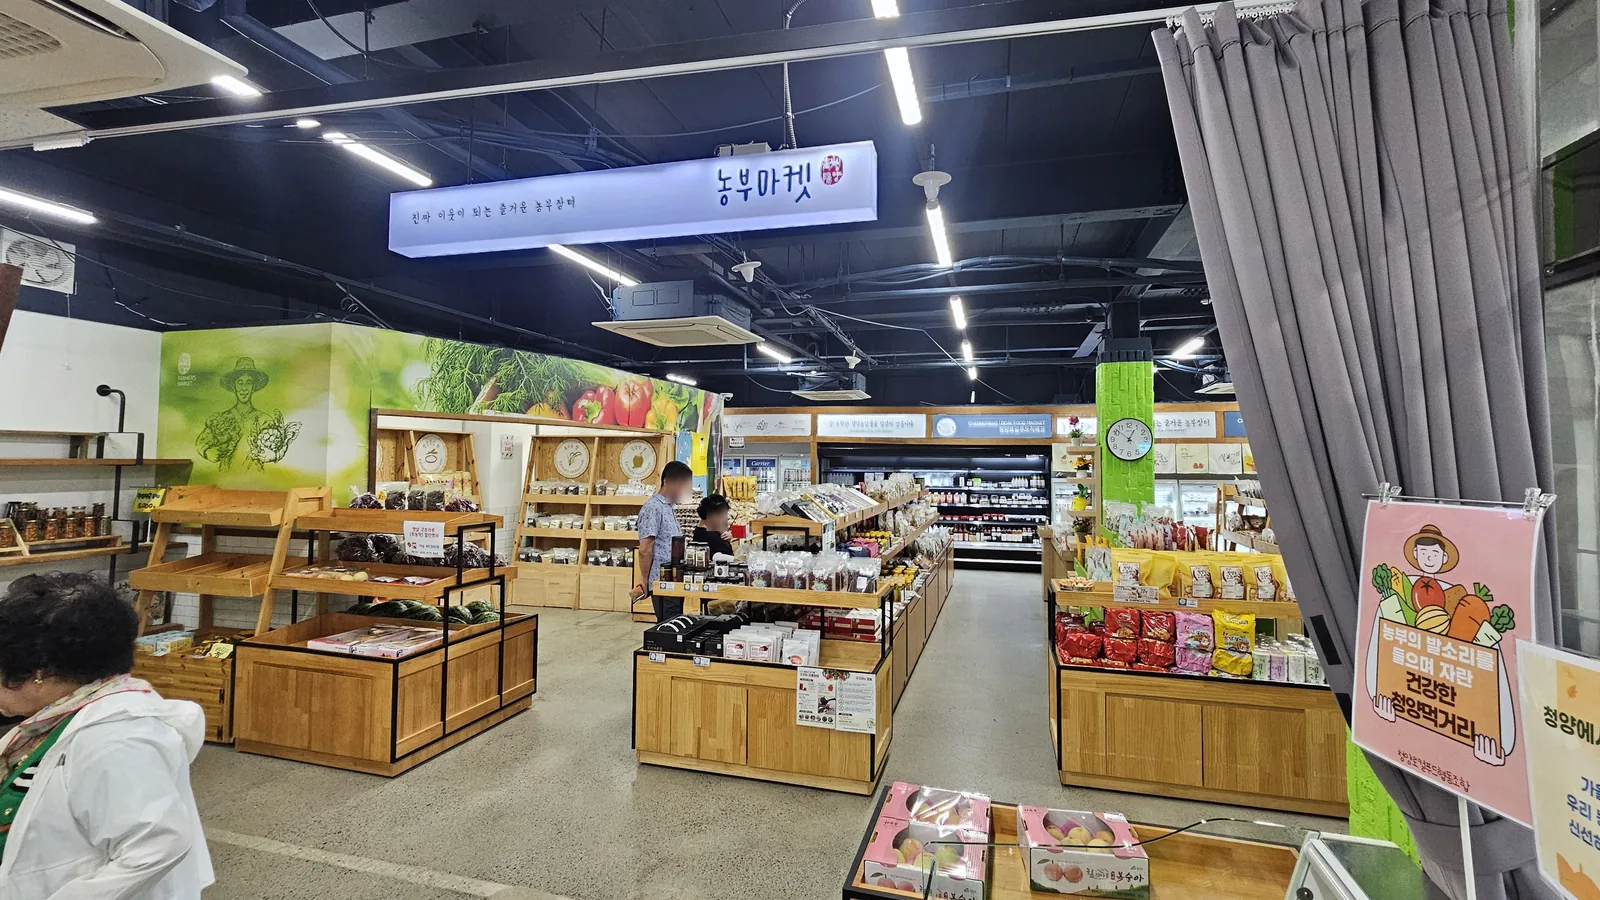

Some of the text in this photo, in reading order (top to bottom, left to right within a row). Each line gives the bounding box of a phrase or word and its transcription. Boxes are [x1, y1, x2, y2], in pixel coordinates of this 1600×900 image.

[717, 162, 811, 206] 농부마켓
[412, 196, 576, 225] 진짜 이웃이 되는 즐거운 농부장터
[1165, 418, 1183, 427] 즐거운
[1185, 417, 1210, 428] 농부장터
[1383, 623, 1494, 672] 농부의 발소리를
[1392, 646, 1473, 688] 들으며 자란
[1406, 671, 1457, 707] 건강한
[1392, 691, 1475, 741] 청양먹거리
[1398, 749, 1470, 793] 청양로컬푸드협동조합
[1567, 794, 1592, 822] 우리
[1116, 870, 1145, 883] 복숭아
